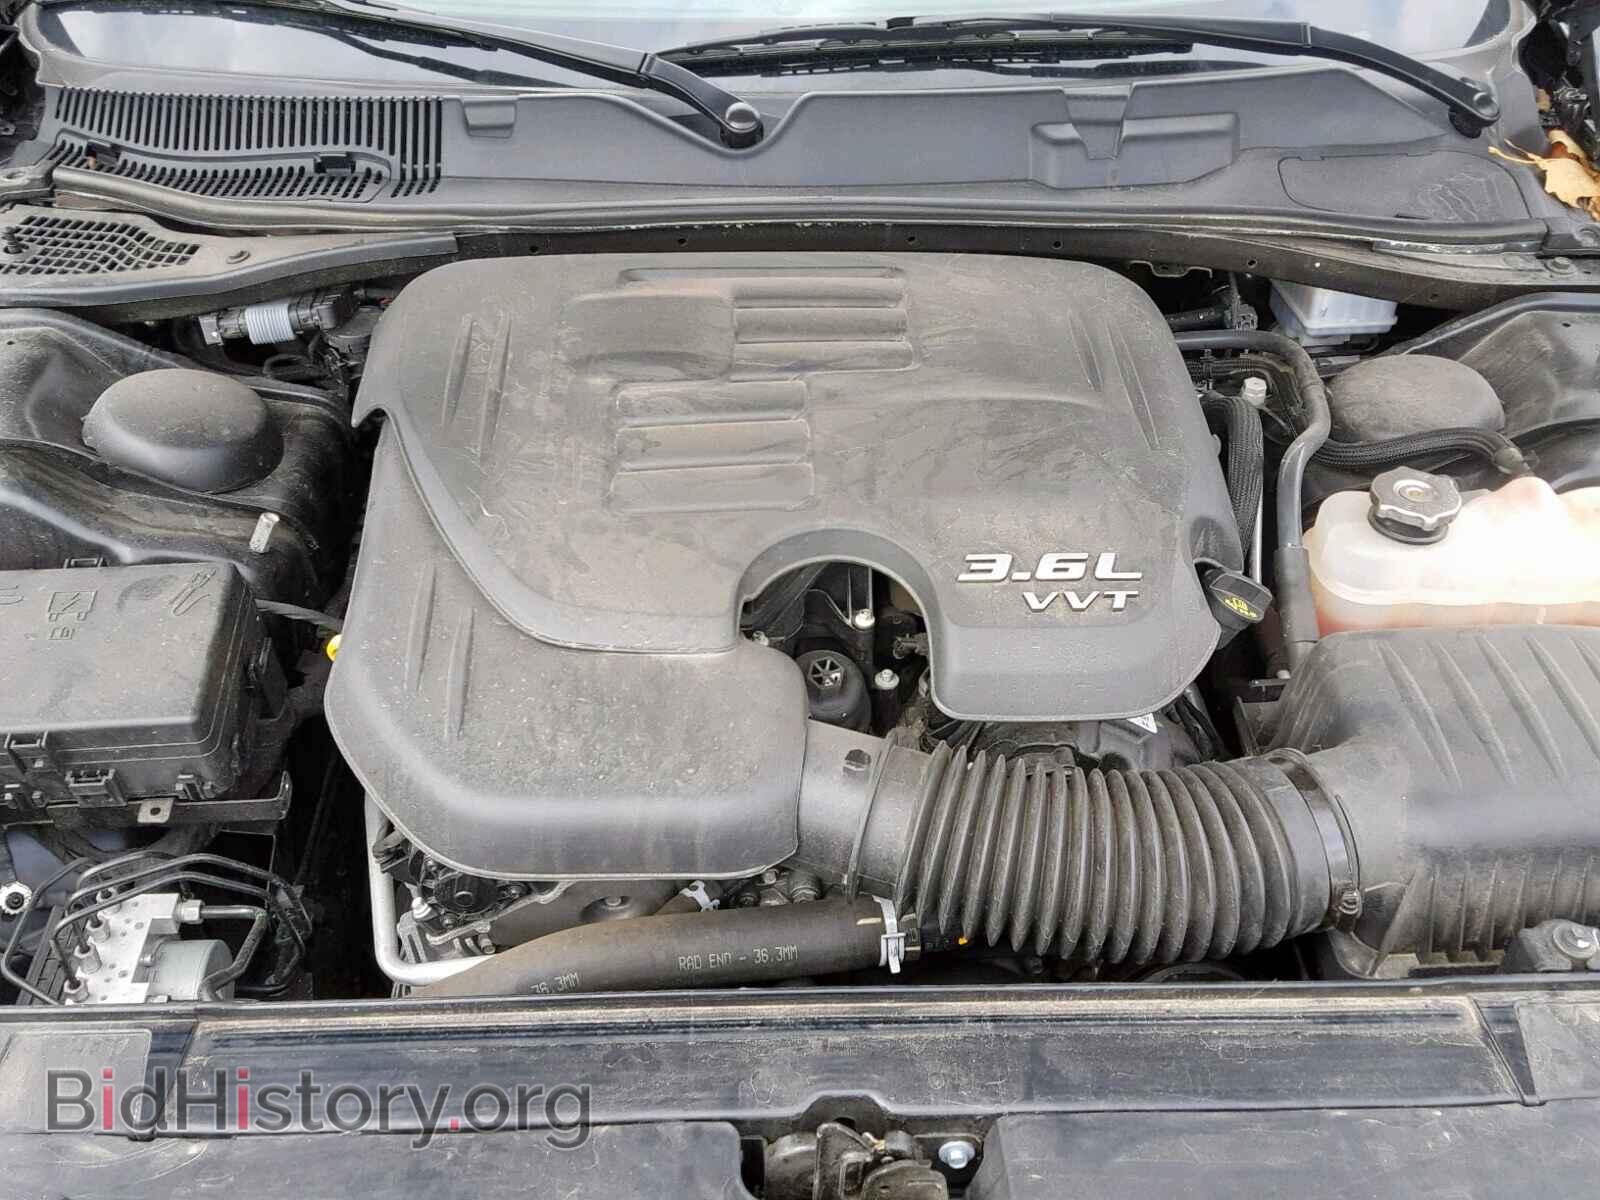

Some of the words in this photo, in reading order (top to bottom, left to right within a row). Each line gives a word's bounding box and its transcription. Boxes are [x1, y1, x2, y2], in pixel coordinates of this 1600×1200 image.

[957, 552, 1143, 583] 3.6L
[1022, 590, 1139, 612] VVT
[678, 955, 701, 970] RAD
